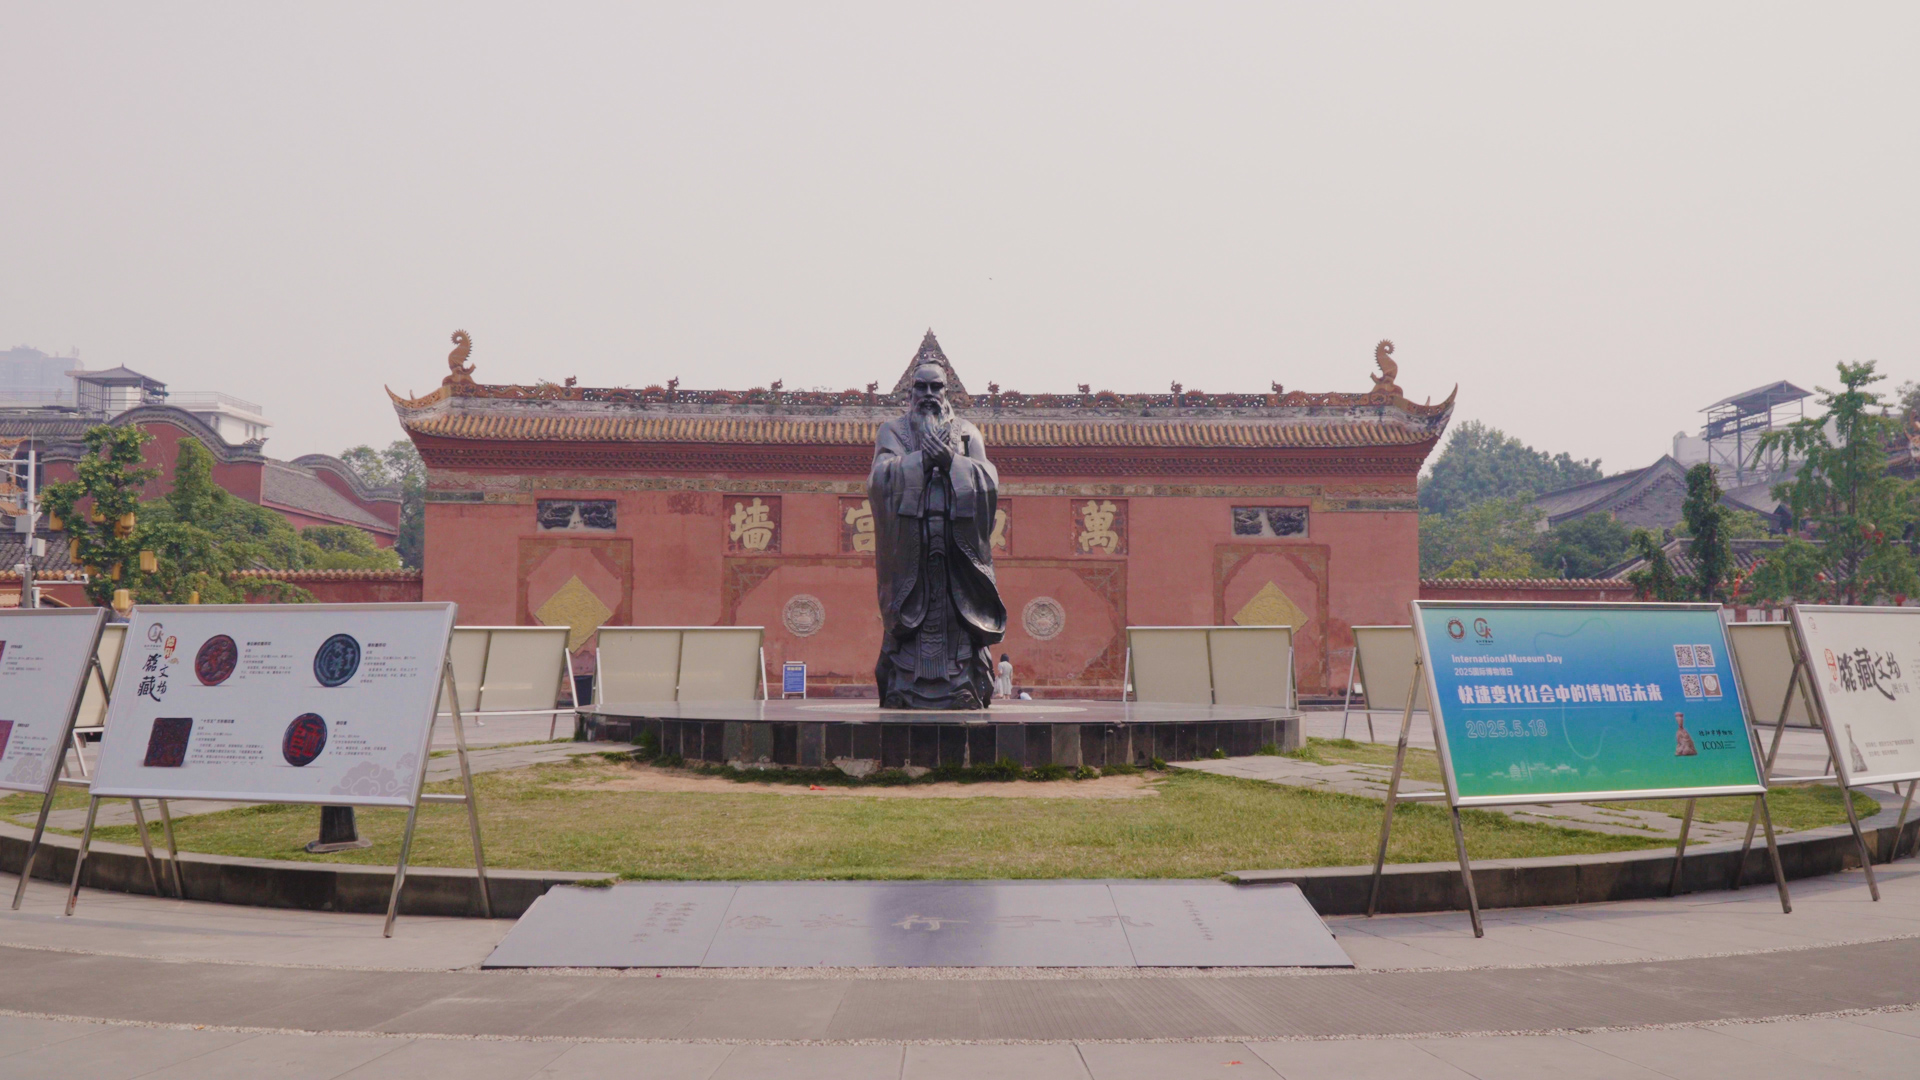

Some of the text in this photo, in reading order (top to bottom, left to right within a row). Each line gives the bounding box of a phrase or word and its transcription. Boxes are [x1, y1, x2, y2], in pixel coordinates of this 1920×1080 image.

[1079, 500, 1118, 555] 萬
[1452, 654, 1563, 664] International Museum Day
[1454, 667, 1514, 676] 2025国际博物馆日
[1458, 684, 1663, 704] 快速变化社会中的博物馆未来
[1465, 719, 1548, 738] 2025.5.18
